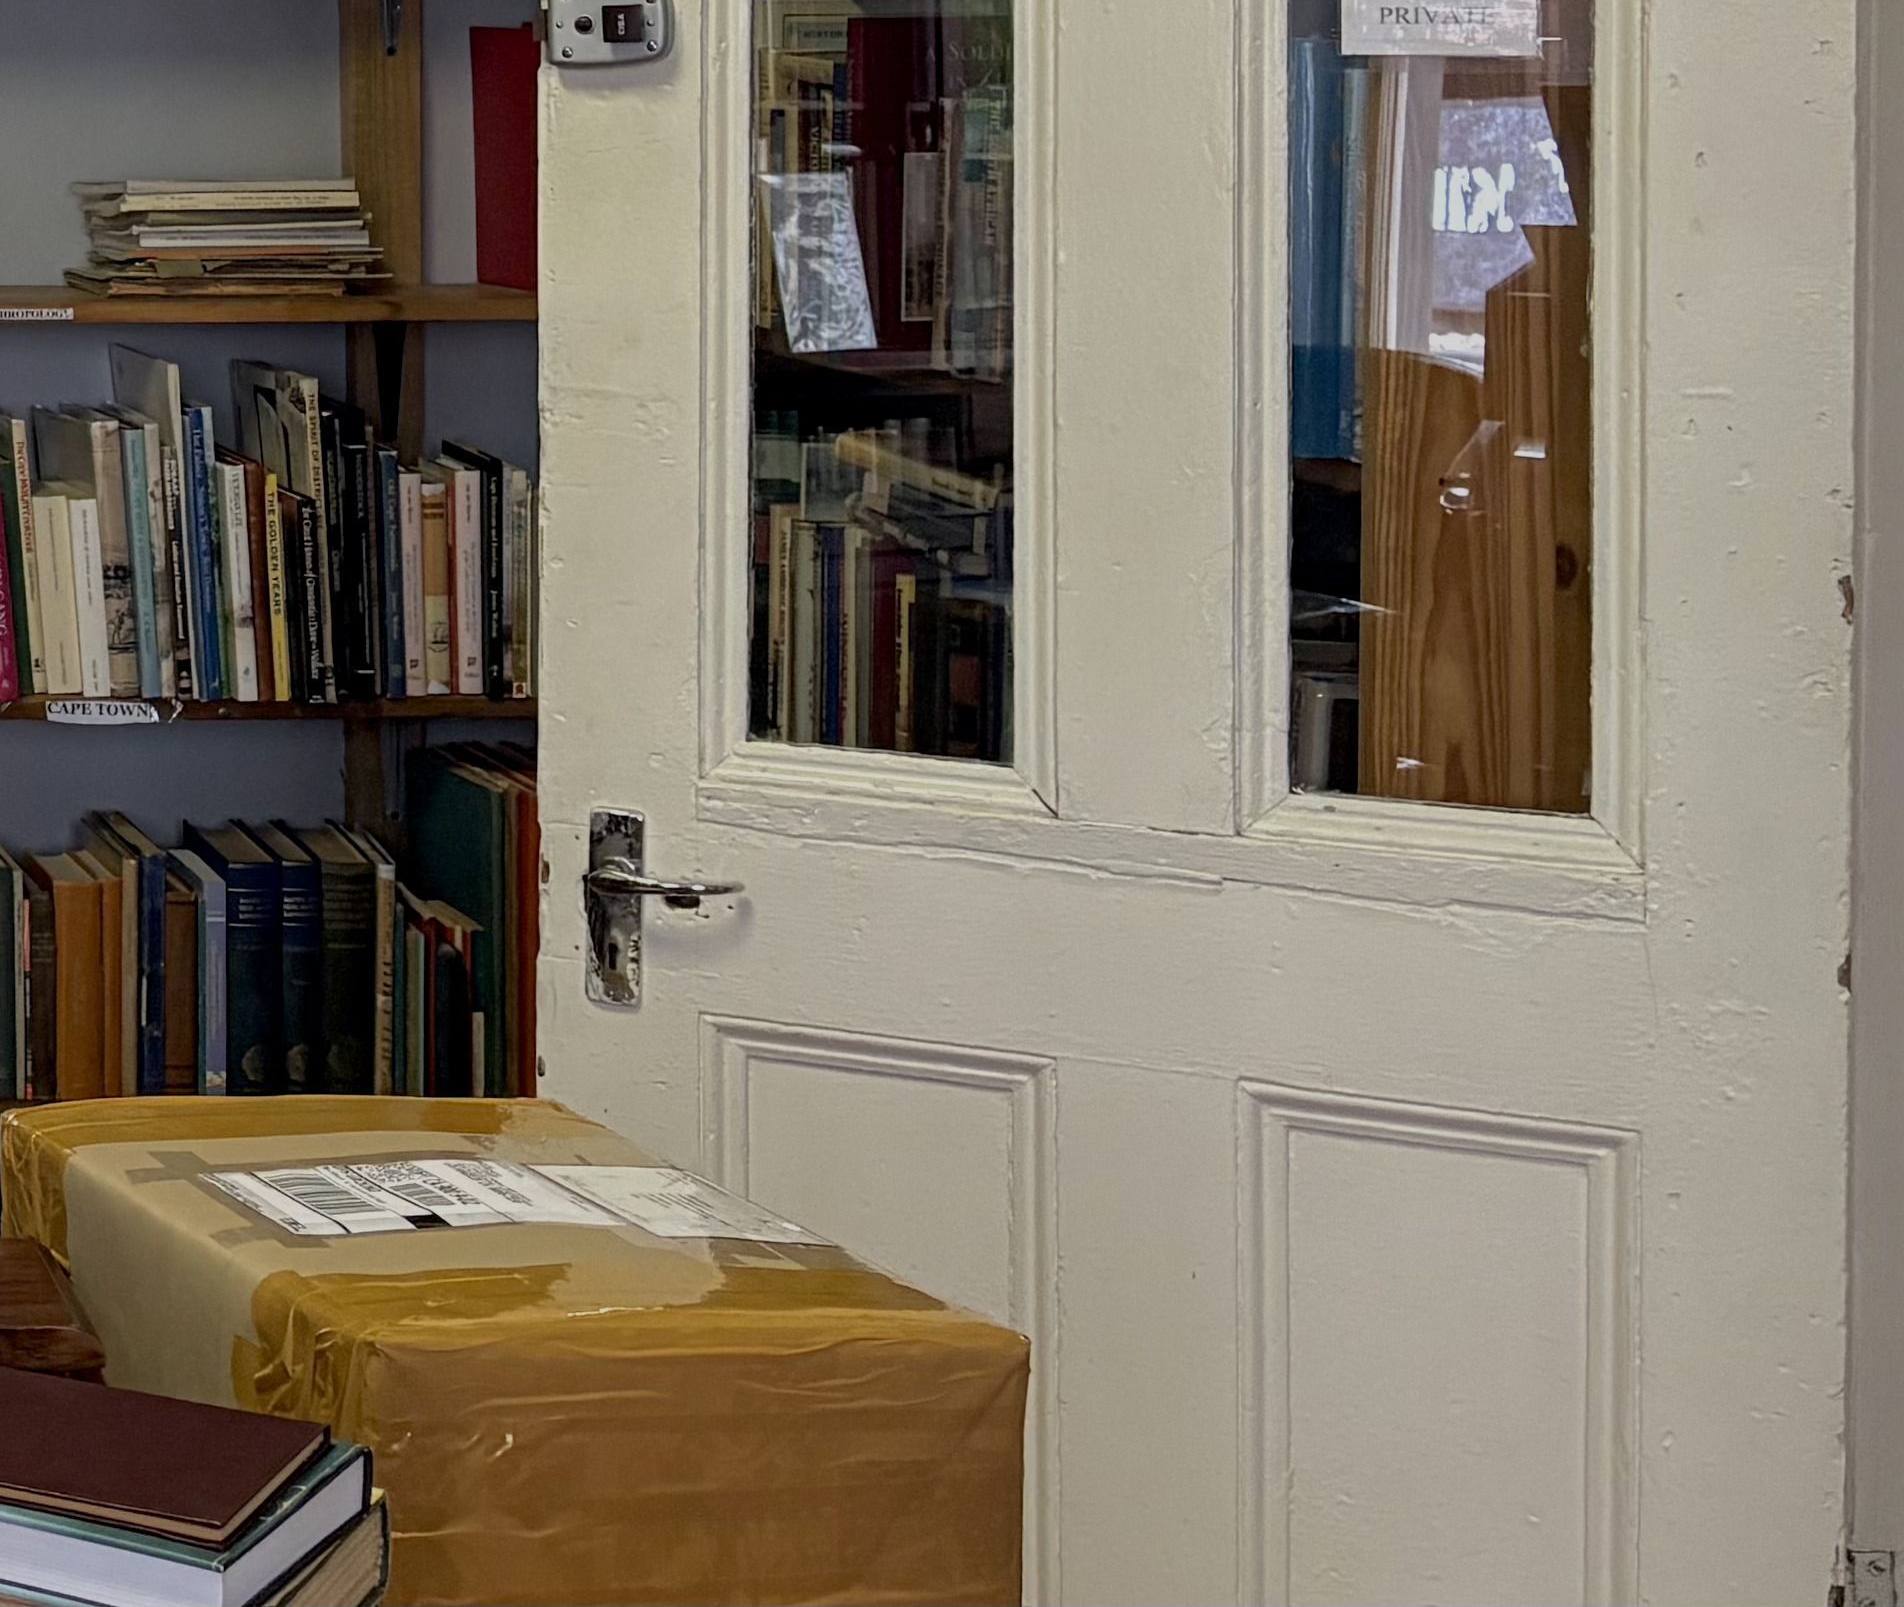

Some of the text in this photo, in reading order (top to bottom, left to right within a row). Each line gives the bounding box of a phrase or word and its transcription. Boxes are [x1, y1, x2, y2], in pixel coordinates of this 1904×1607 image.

[1379, 6, 1491, 26] PRIVATE
[266, 492, 281, 616] THE GOLDEN YEARS
[47, 701, 148, 718] CAPE TOWN
